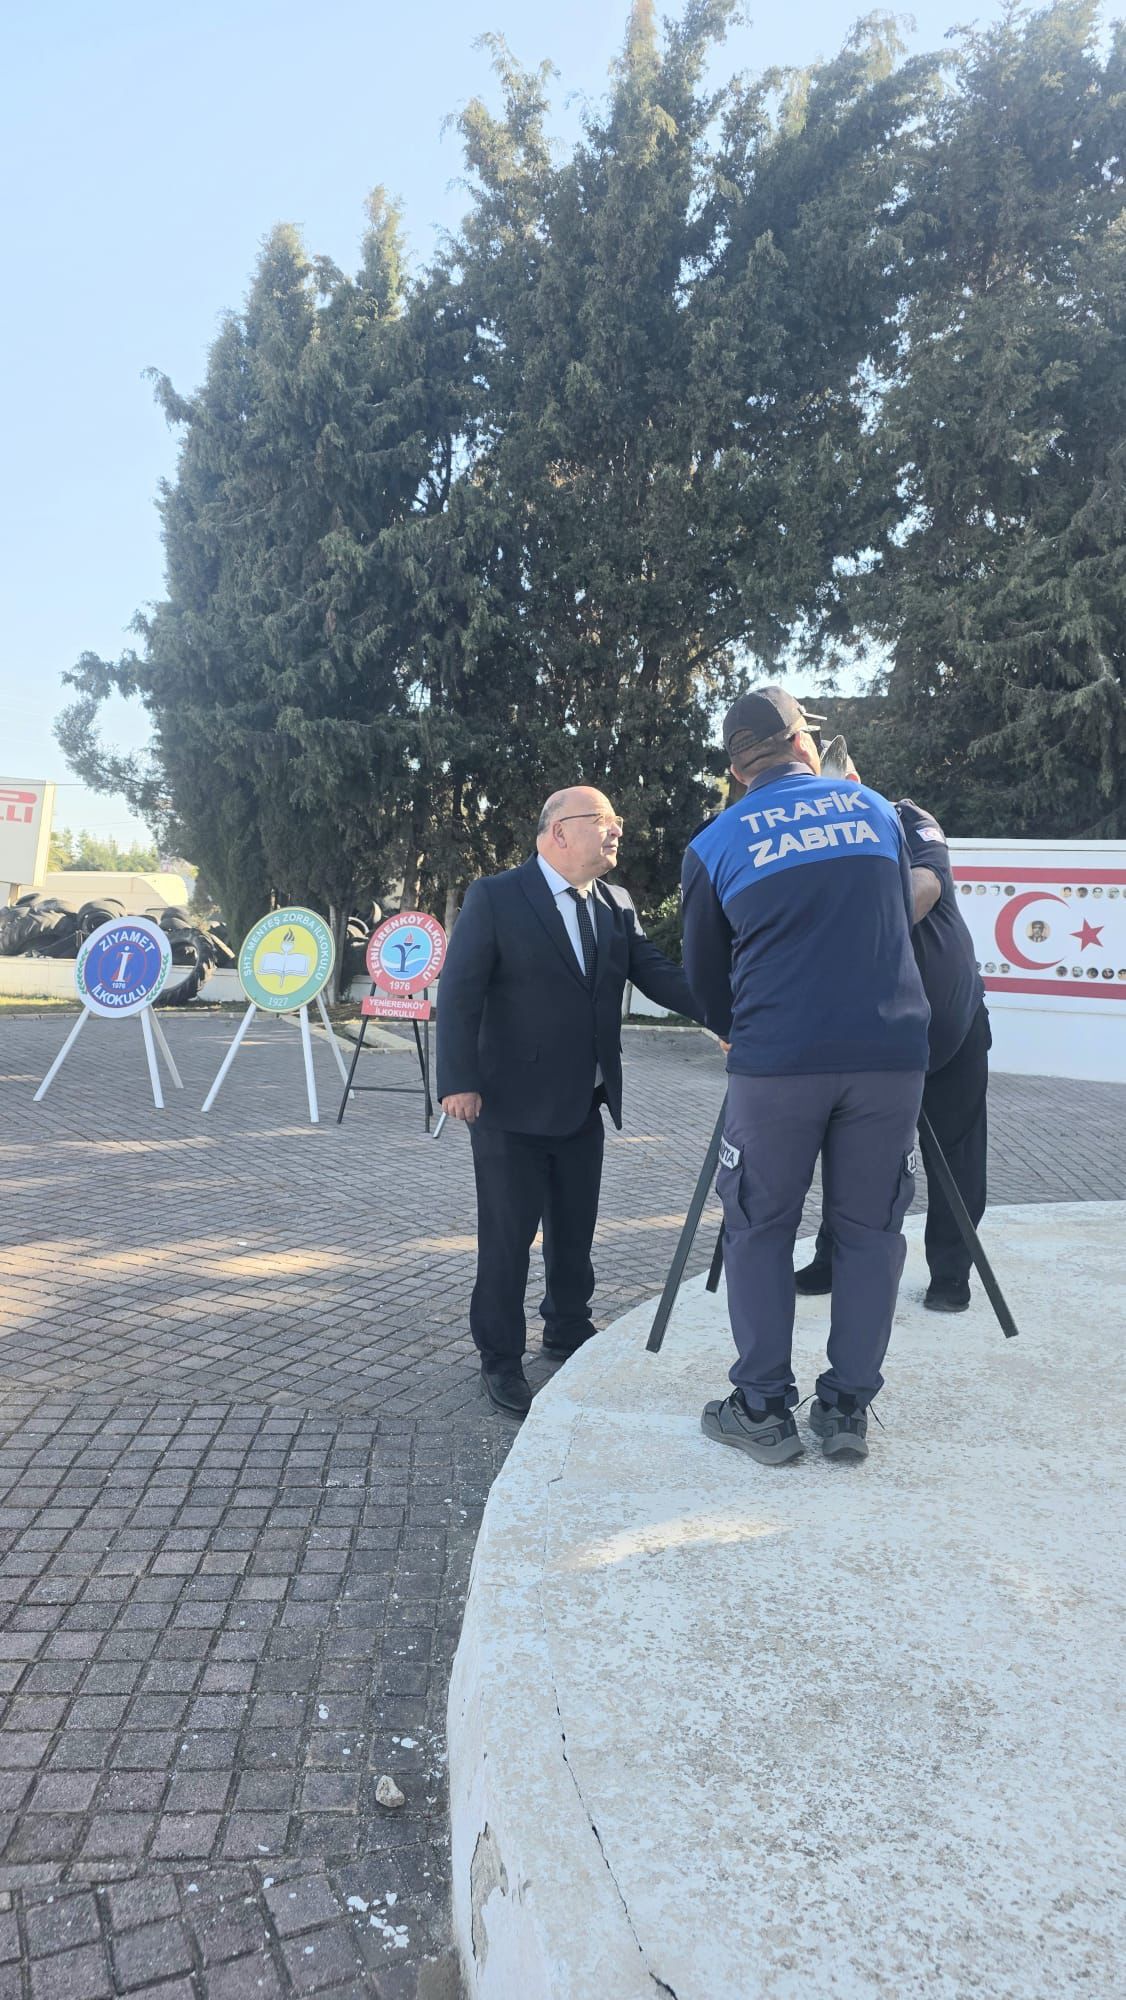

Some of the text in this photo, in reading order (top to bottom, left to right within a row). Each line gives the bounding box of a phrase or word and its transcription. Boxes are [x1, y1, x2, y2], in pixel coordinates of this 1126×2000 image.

[740, 791, 870, 834] TRAFİK
[748, 820, 880, 868] ZABITA
[99, 931, 155, 952] ZİYAMET
[282, 913, 315, 928] ZORBA
[313, 925, 329, 980] İLKOKULU
[370, 914, 443, 980] YENİERENKÖY İLKOKULU
[91, 982, 147, 1006] İLKOKULU
[389, 981, 410, 990] 1976
[369, 999, 425, 1010] YENİERENKÖY
[375, 1007, 415, 1017] İLKOKULU
